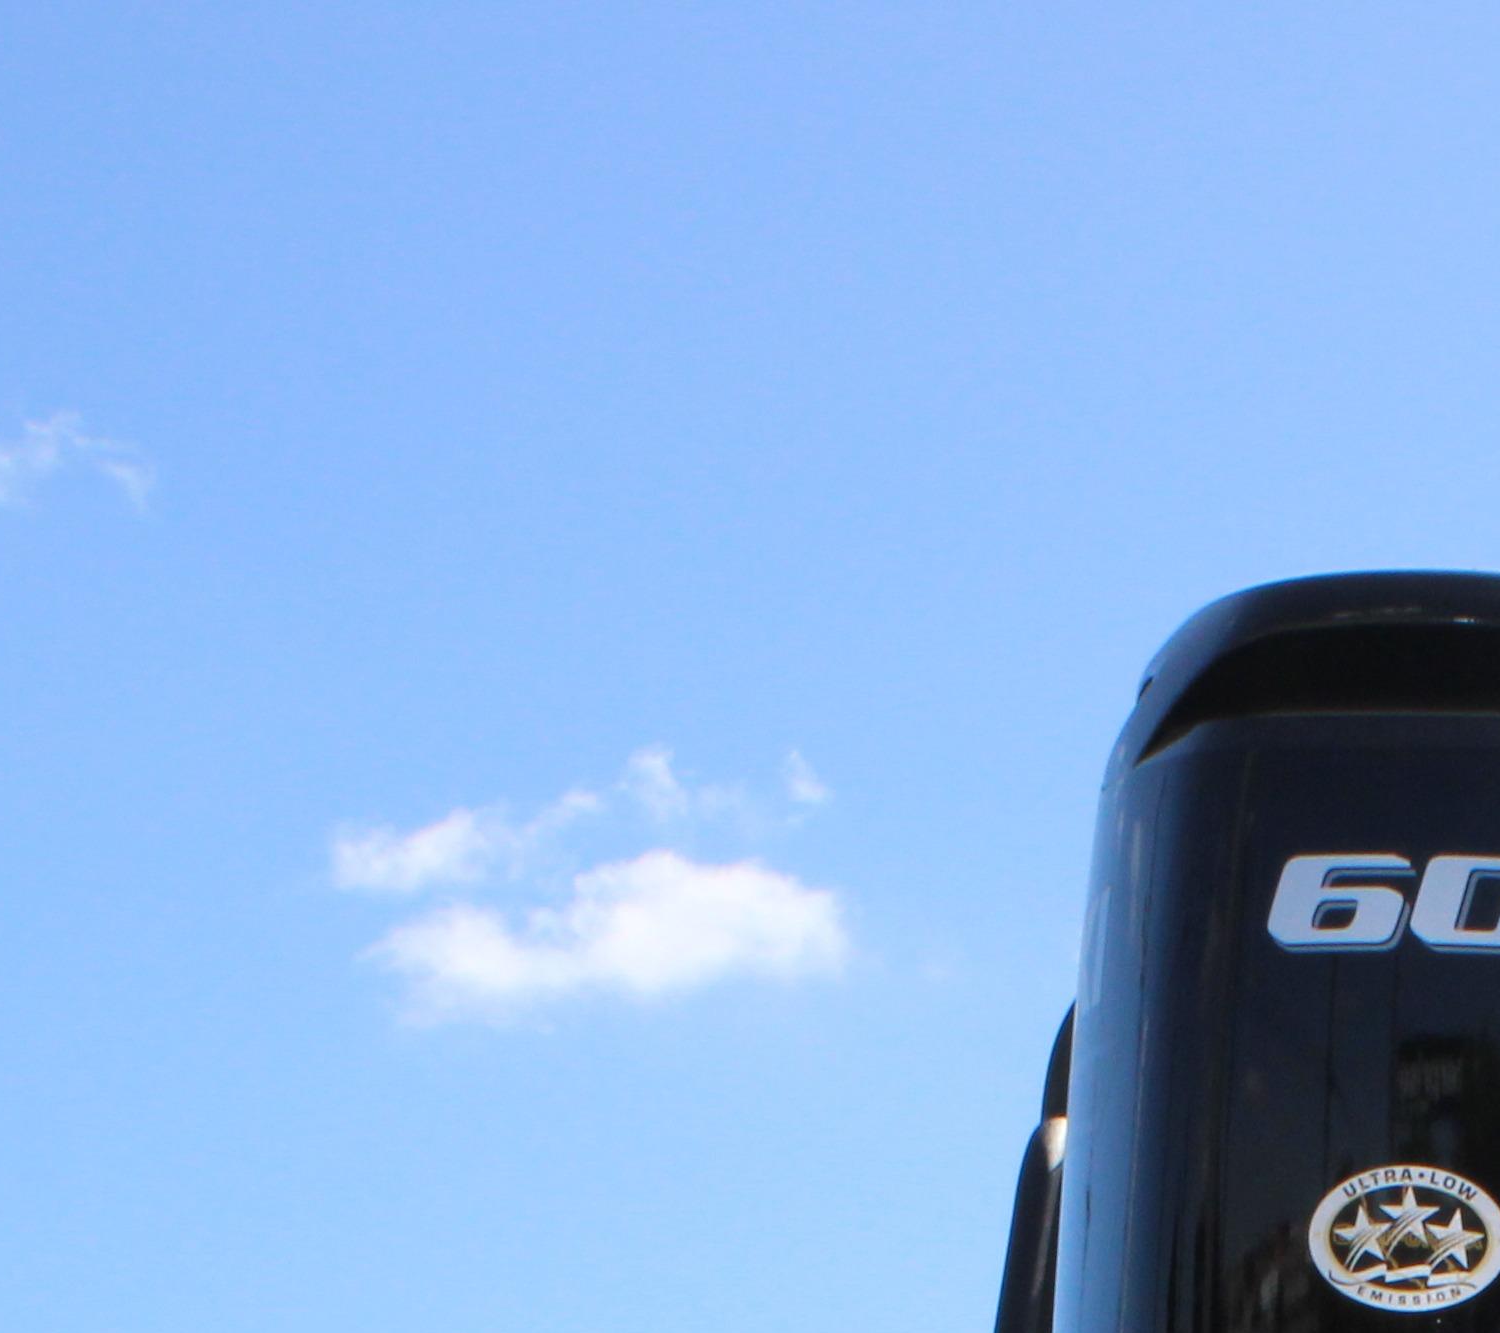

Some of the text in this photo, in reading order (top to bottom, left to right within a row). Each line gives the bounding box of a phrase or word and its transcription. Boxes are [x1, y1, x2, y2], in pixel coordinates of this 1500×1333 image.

[1342, 1168, 1477, 1201] ULTRA LOW
[1357, 1285, 1462, 1305] EMISSION
